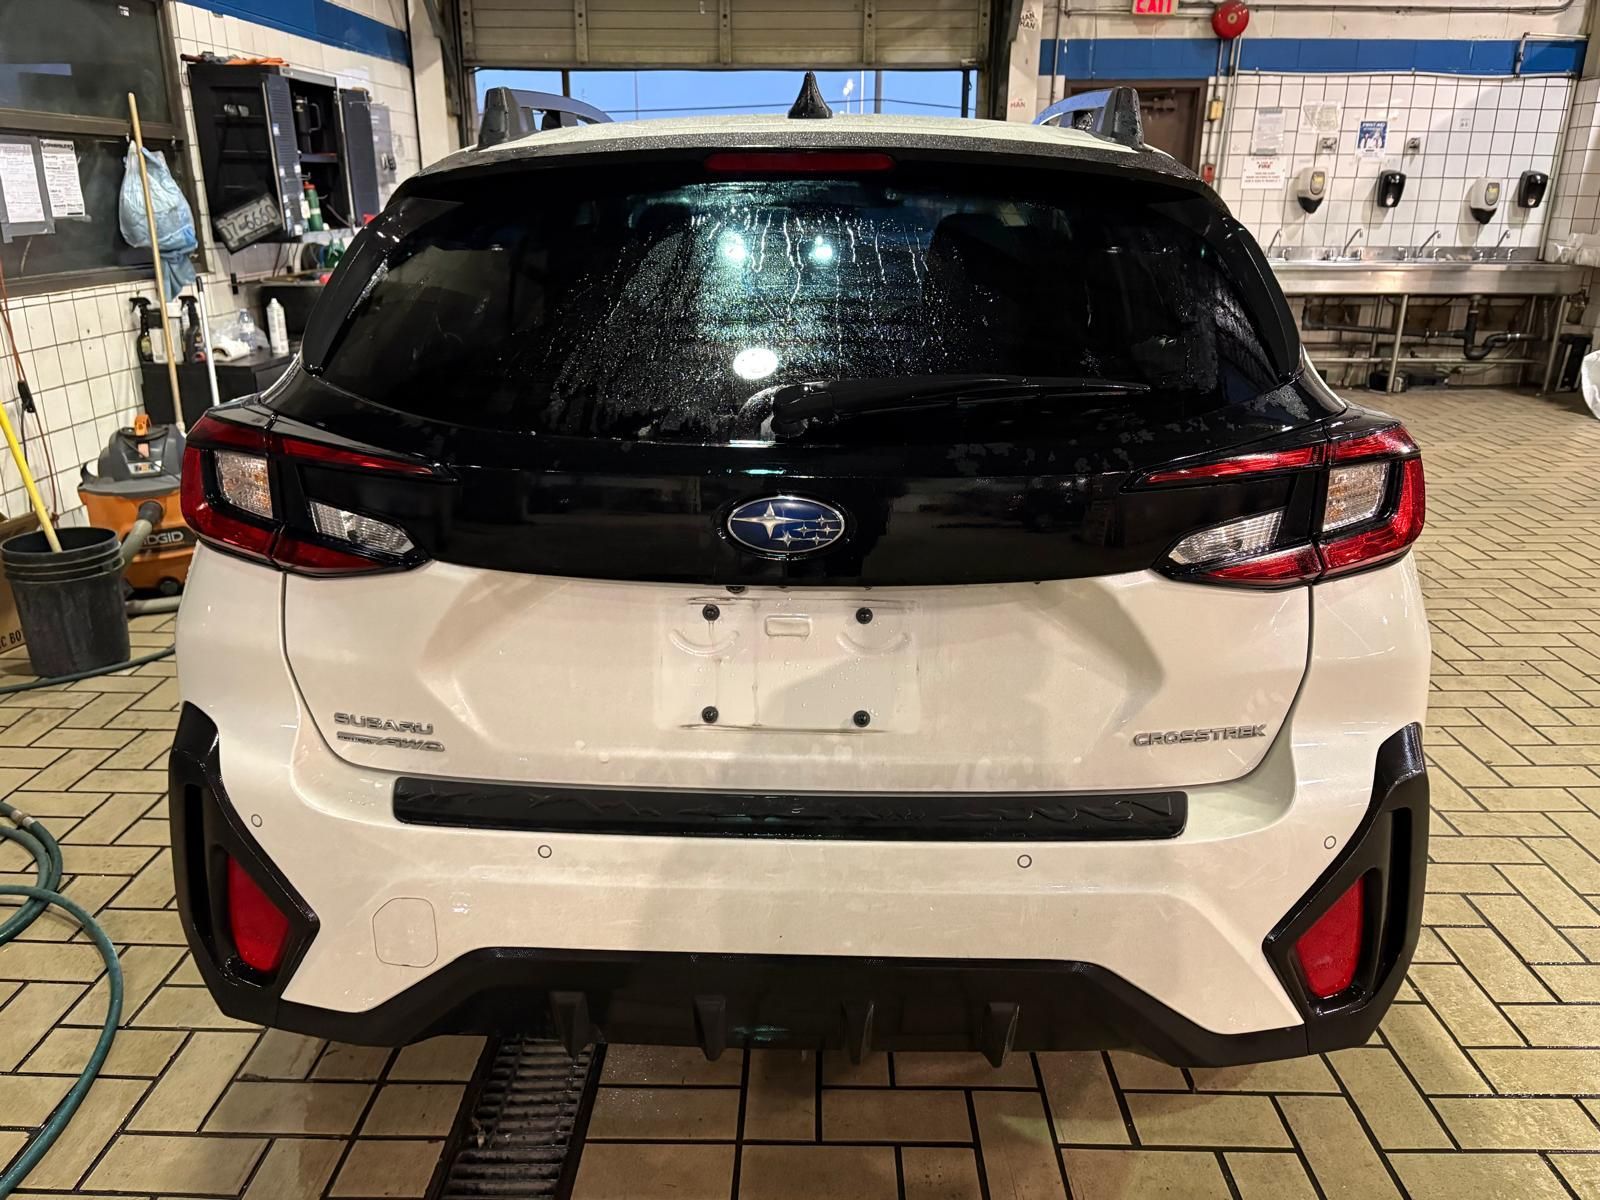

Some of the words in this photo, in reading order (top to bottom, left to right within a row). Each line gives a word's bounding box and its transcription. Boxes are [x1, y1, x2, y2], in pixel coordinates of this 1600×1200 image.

[143, 531, 184, 545] IDGID
[9, 630, 22, 645] BO
[333, 712, 433, 735] SUBARU
[1133, 724, 1266, 746] CROSSTREK
[376, 738, 445, 752] AWD
